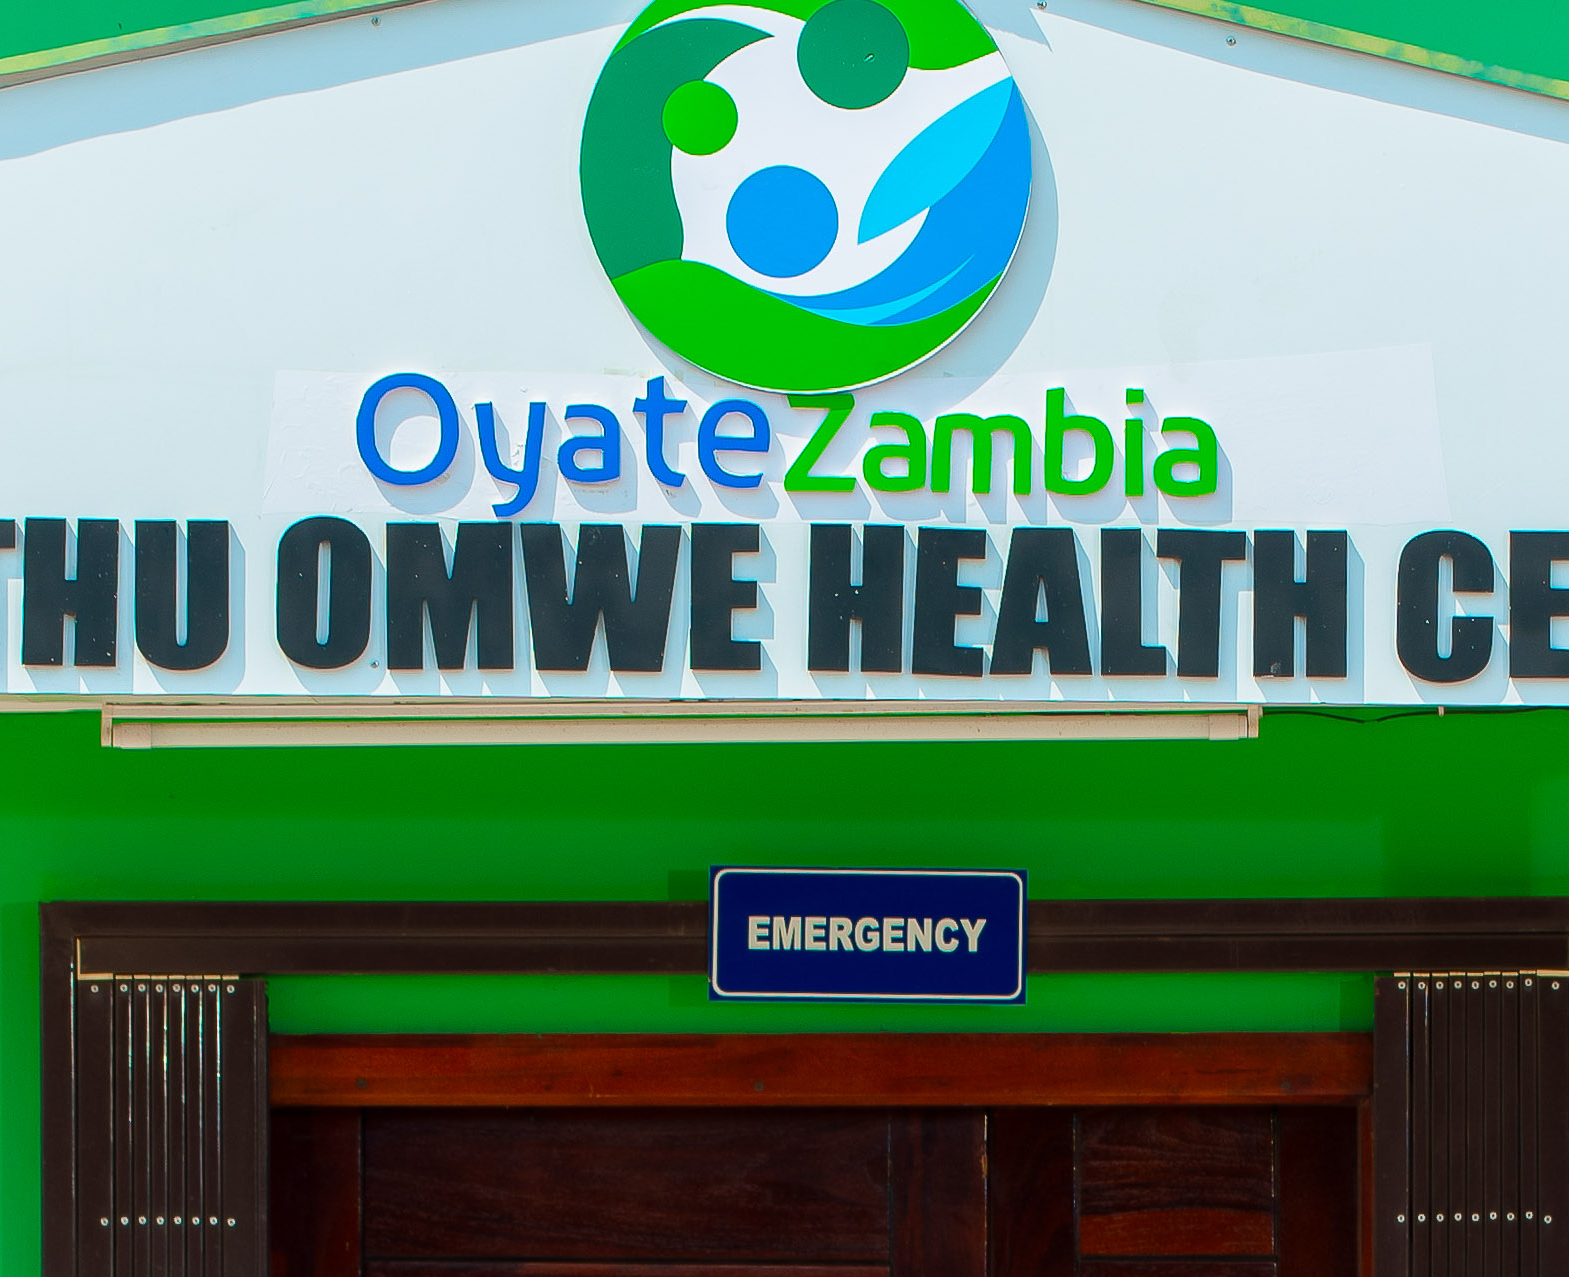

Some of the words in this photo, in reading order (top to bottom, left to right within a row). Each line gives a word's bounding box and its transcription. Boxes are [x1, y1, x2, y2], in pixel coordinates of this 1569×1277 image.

[275, 515, 762, 672] OMWE
[808, 522, 1349, 678] HEALTH
[747, 915, 987, 953] EMERGENCY
